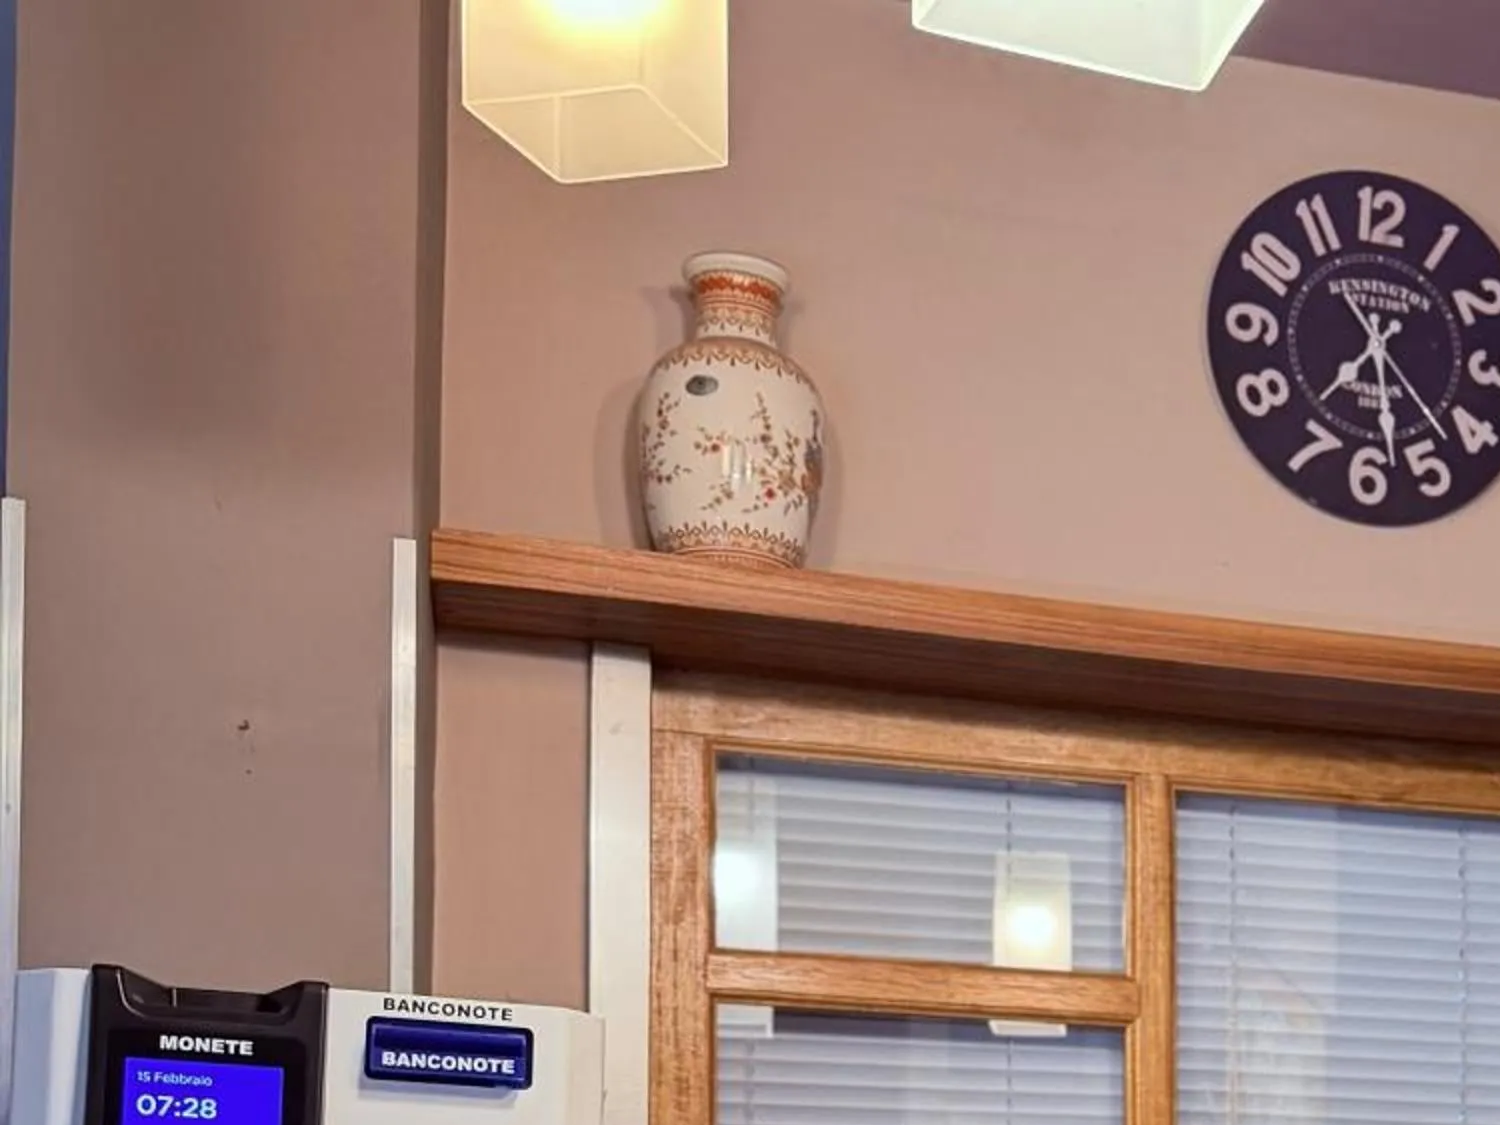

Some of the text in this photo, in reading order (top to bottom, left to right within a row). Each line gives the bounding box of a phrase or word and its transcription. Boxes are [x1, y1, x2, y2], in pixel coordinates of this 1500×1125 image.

[1295, 193, 1342, 257] 11
[1358, 186, 1406, 248] 12
[1240, 232, 1301, 297] 10
[1423, 224, 1460, 272] 1
[1225, 302, 1279, 347] 9
[1236, 368, 1290, 417] 8
[1287, 418, 1343, 472] 7
[1451, 405, 1498, 455] 4
[1348, 446, 1388, 506] 6
[1403, 438, 1451, 497] 5
[383, 997, 513, 1021] BANCONOTE
[159, 1034, 254, 1056] MONETE
[381, 1051, 515, 1074] BANCONOTE
[137, 1070, 213, 1087] 15 Febbraio
[136, 1093, 218, 1120] 07:28
